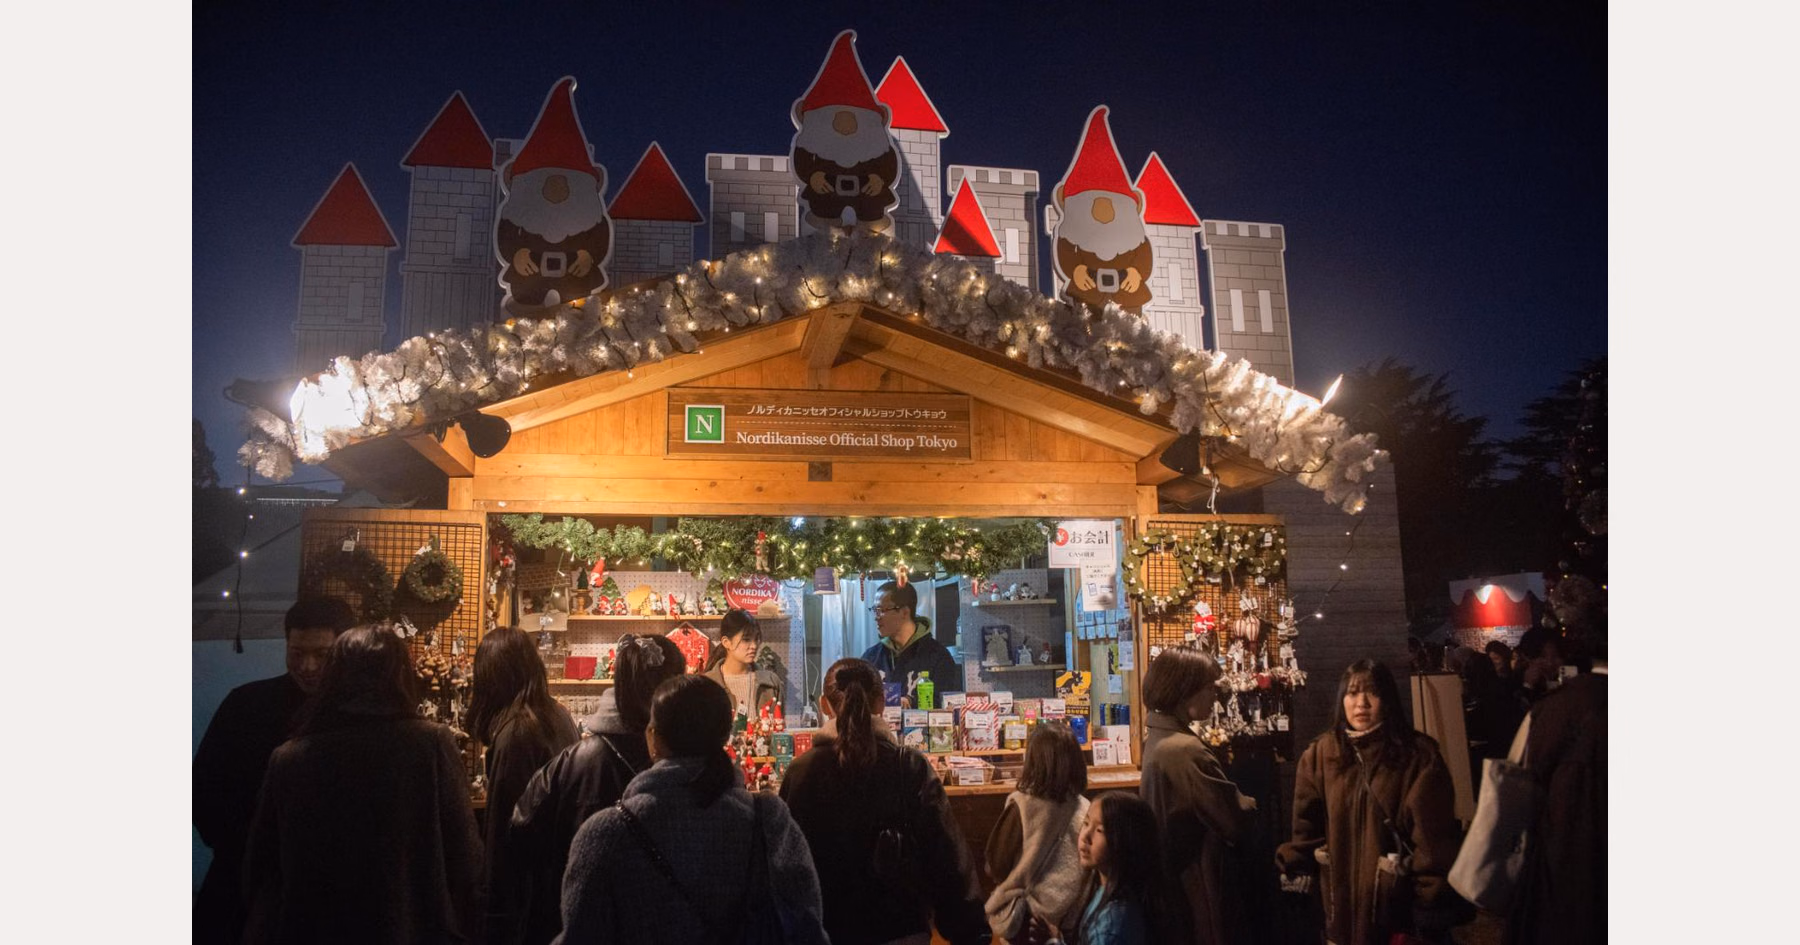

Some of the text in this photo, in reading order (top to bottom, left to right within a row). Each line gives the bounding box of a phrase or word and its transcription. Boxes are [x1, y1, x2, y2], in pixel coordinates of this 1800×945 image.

[747, 404, 947, 420] ノルディカニッセオフィシャルショップトウキョウ
[695, 414, 714, 434] N
[736, 431, 958, 451] Nordikanisse Official Shop Tokyo
[1069, 530, 1109, 544] お会計
[732, 587, 772, 598] NORDIKA
